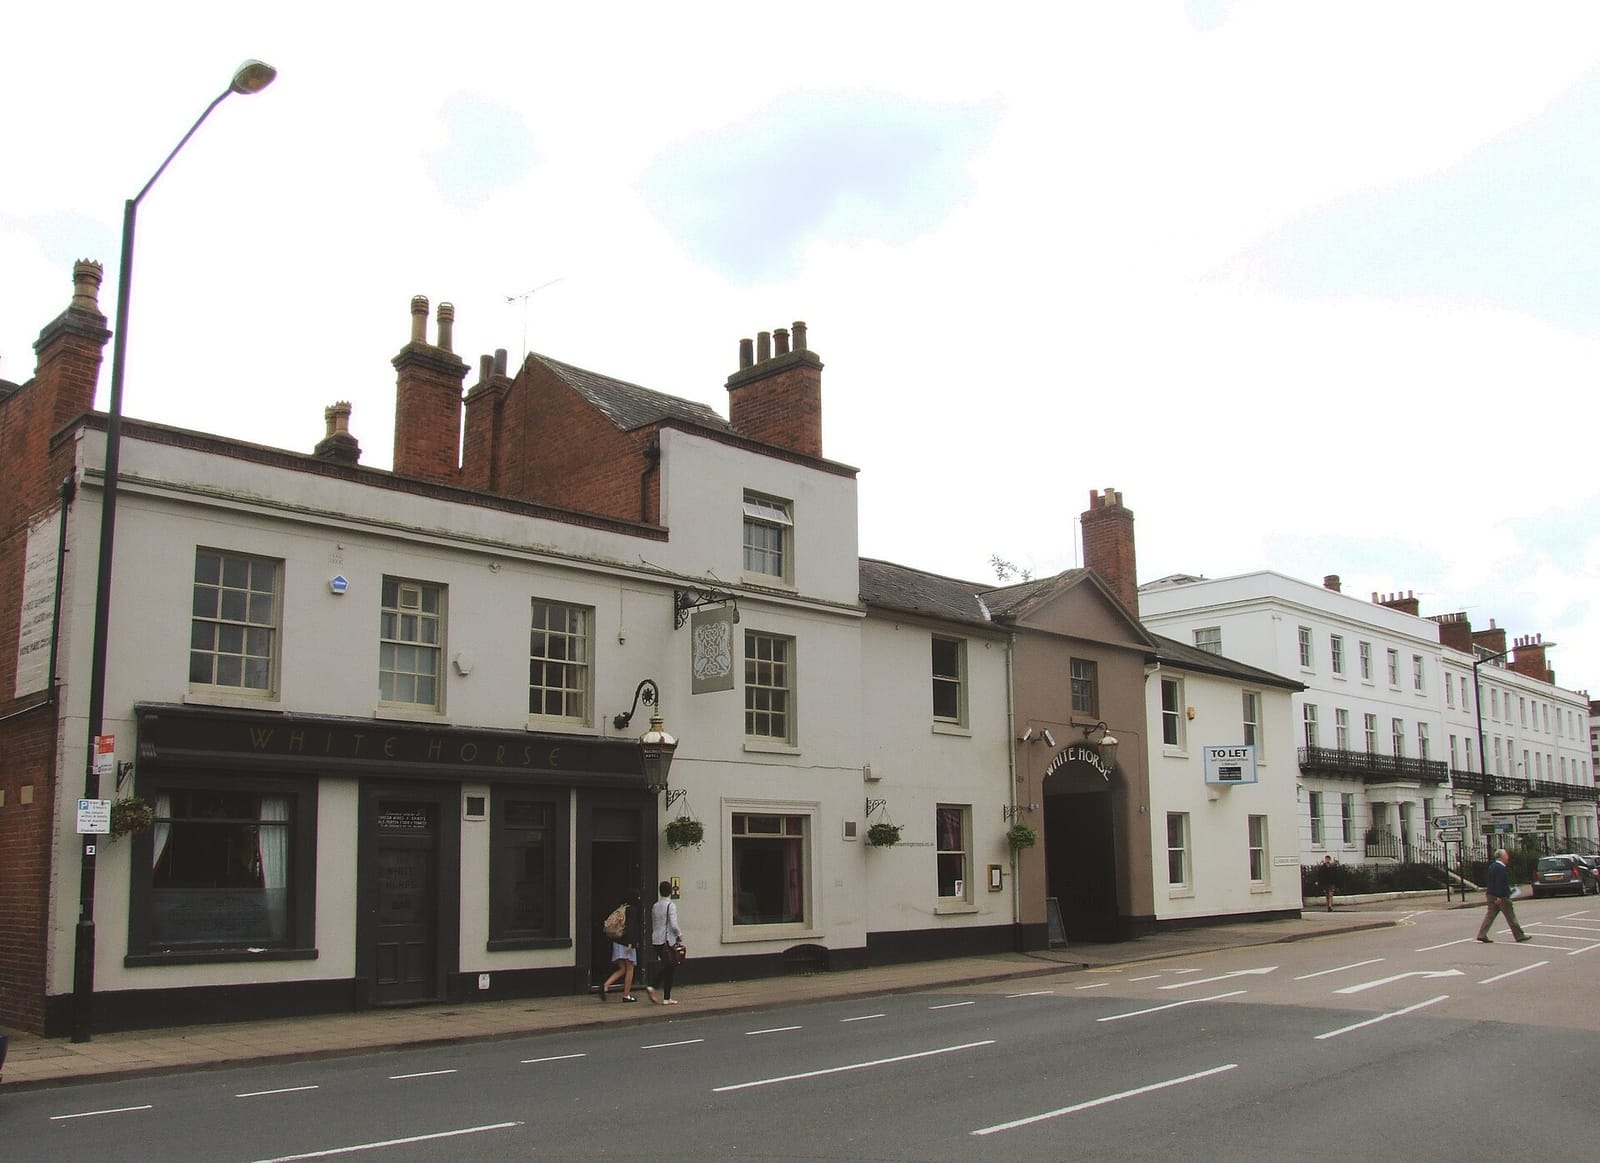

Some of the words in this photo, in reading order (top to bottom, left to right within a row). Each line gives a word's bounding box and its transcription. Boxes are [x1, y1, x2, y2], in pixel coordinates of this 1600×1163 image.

[250, 728, 399, 758] WHITE
[427, 736, 561, 767] HORSE
[1046, 747, 1076, 776] WHITE
[1078, 747, 1113, 781] HORSE
[1211, 749, 1226, 758] TO
[1228, 749, 1248, 758] LET
